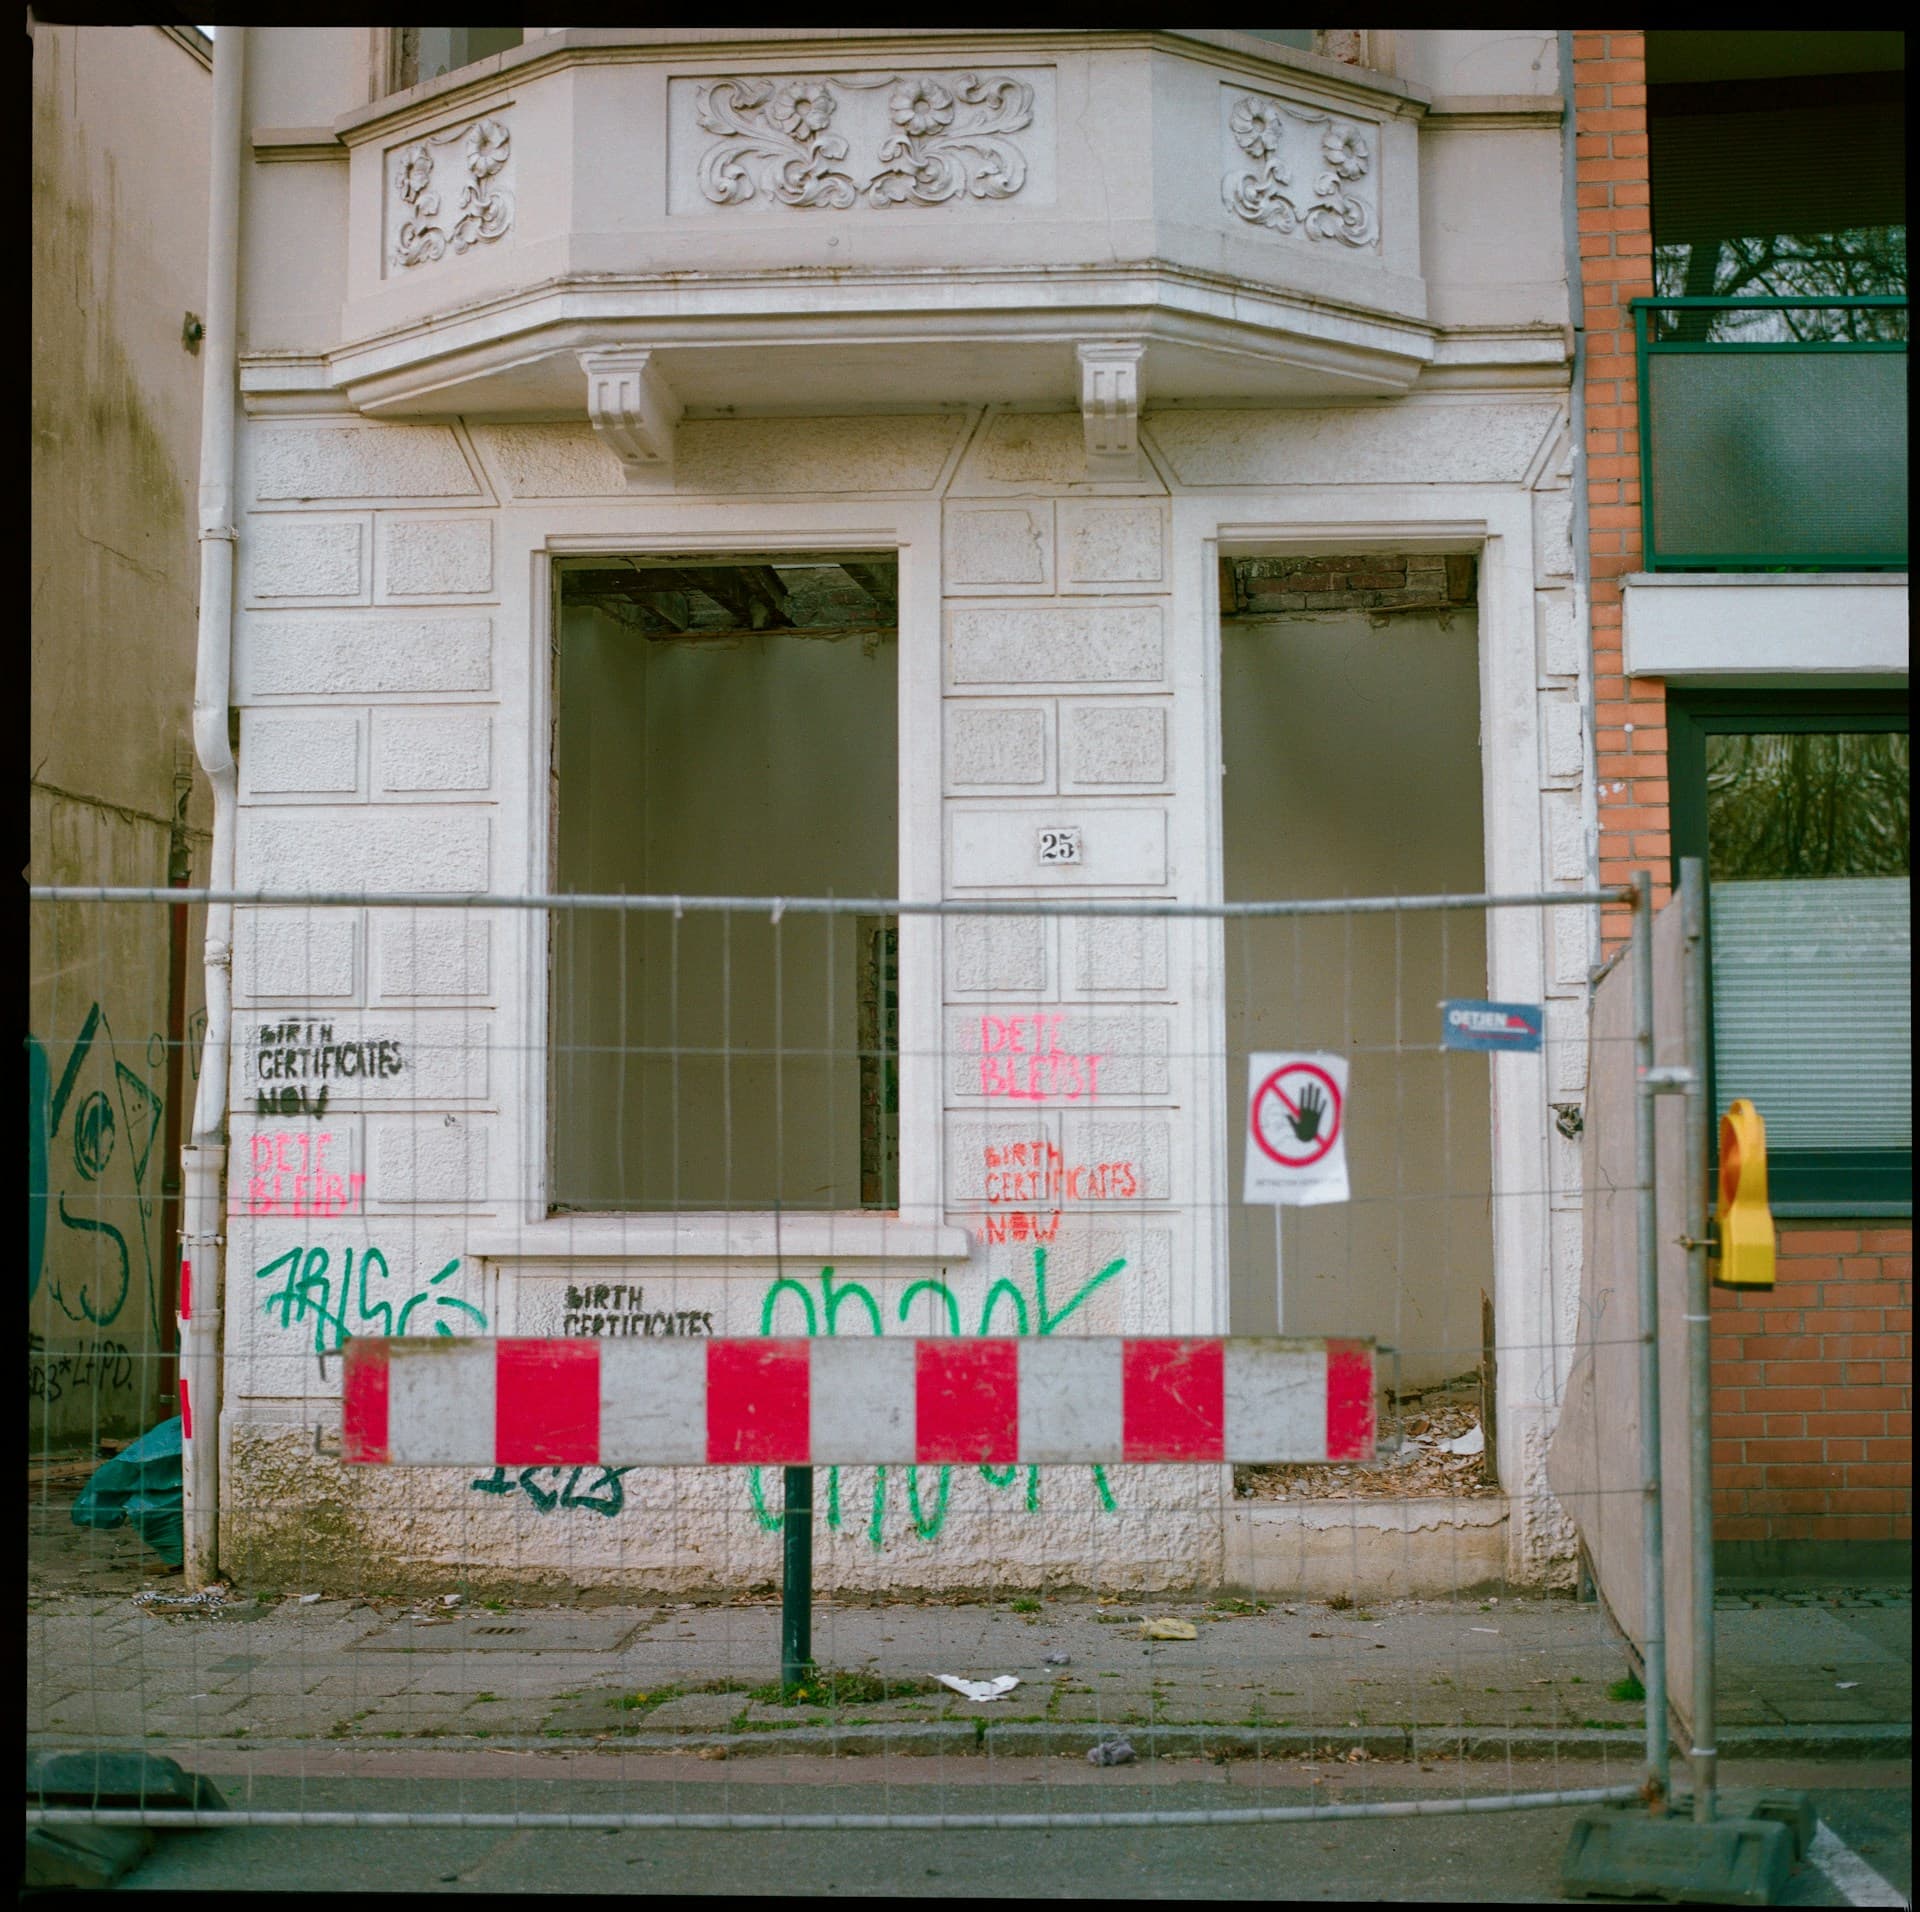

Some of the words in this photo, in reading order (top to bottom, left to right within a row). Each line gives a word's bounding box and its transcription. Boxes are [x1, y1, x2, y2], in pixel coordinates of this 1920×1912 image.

[1042, 833, 1075, 860] 25
[258, 1023, 334, 1046] BIRTH
[980, 1013, 1066, 1054] DETE
[257, 1040, 403, 1079] CERTIFICATES
[256, 1085, 330, 1120] NOW
[249, 1132, 333, 1173] DETE
[983, 1141, 1063, 1175] BIRTH
[247, 1173, 366, 1219] BLEIBT
[985, 1210, 1063, 1245] NOW
[565, 1284, 644, 1311] BIRTH
